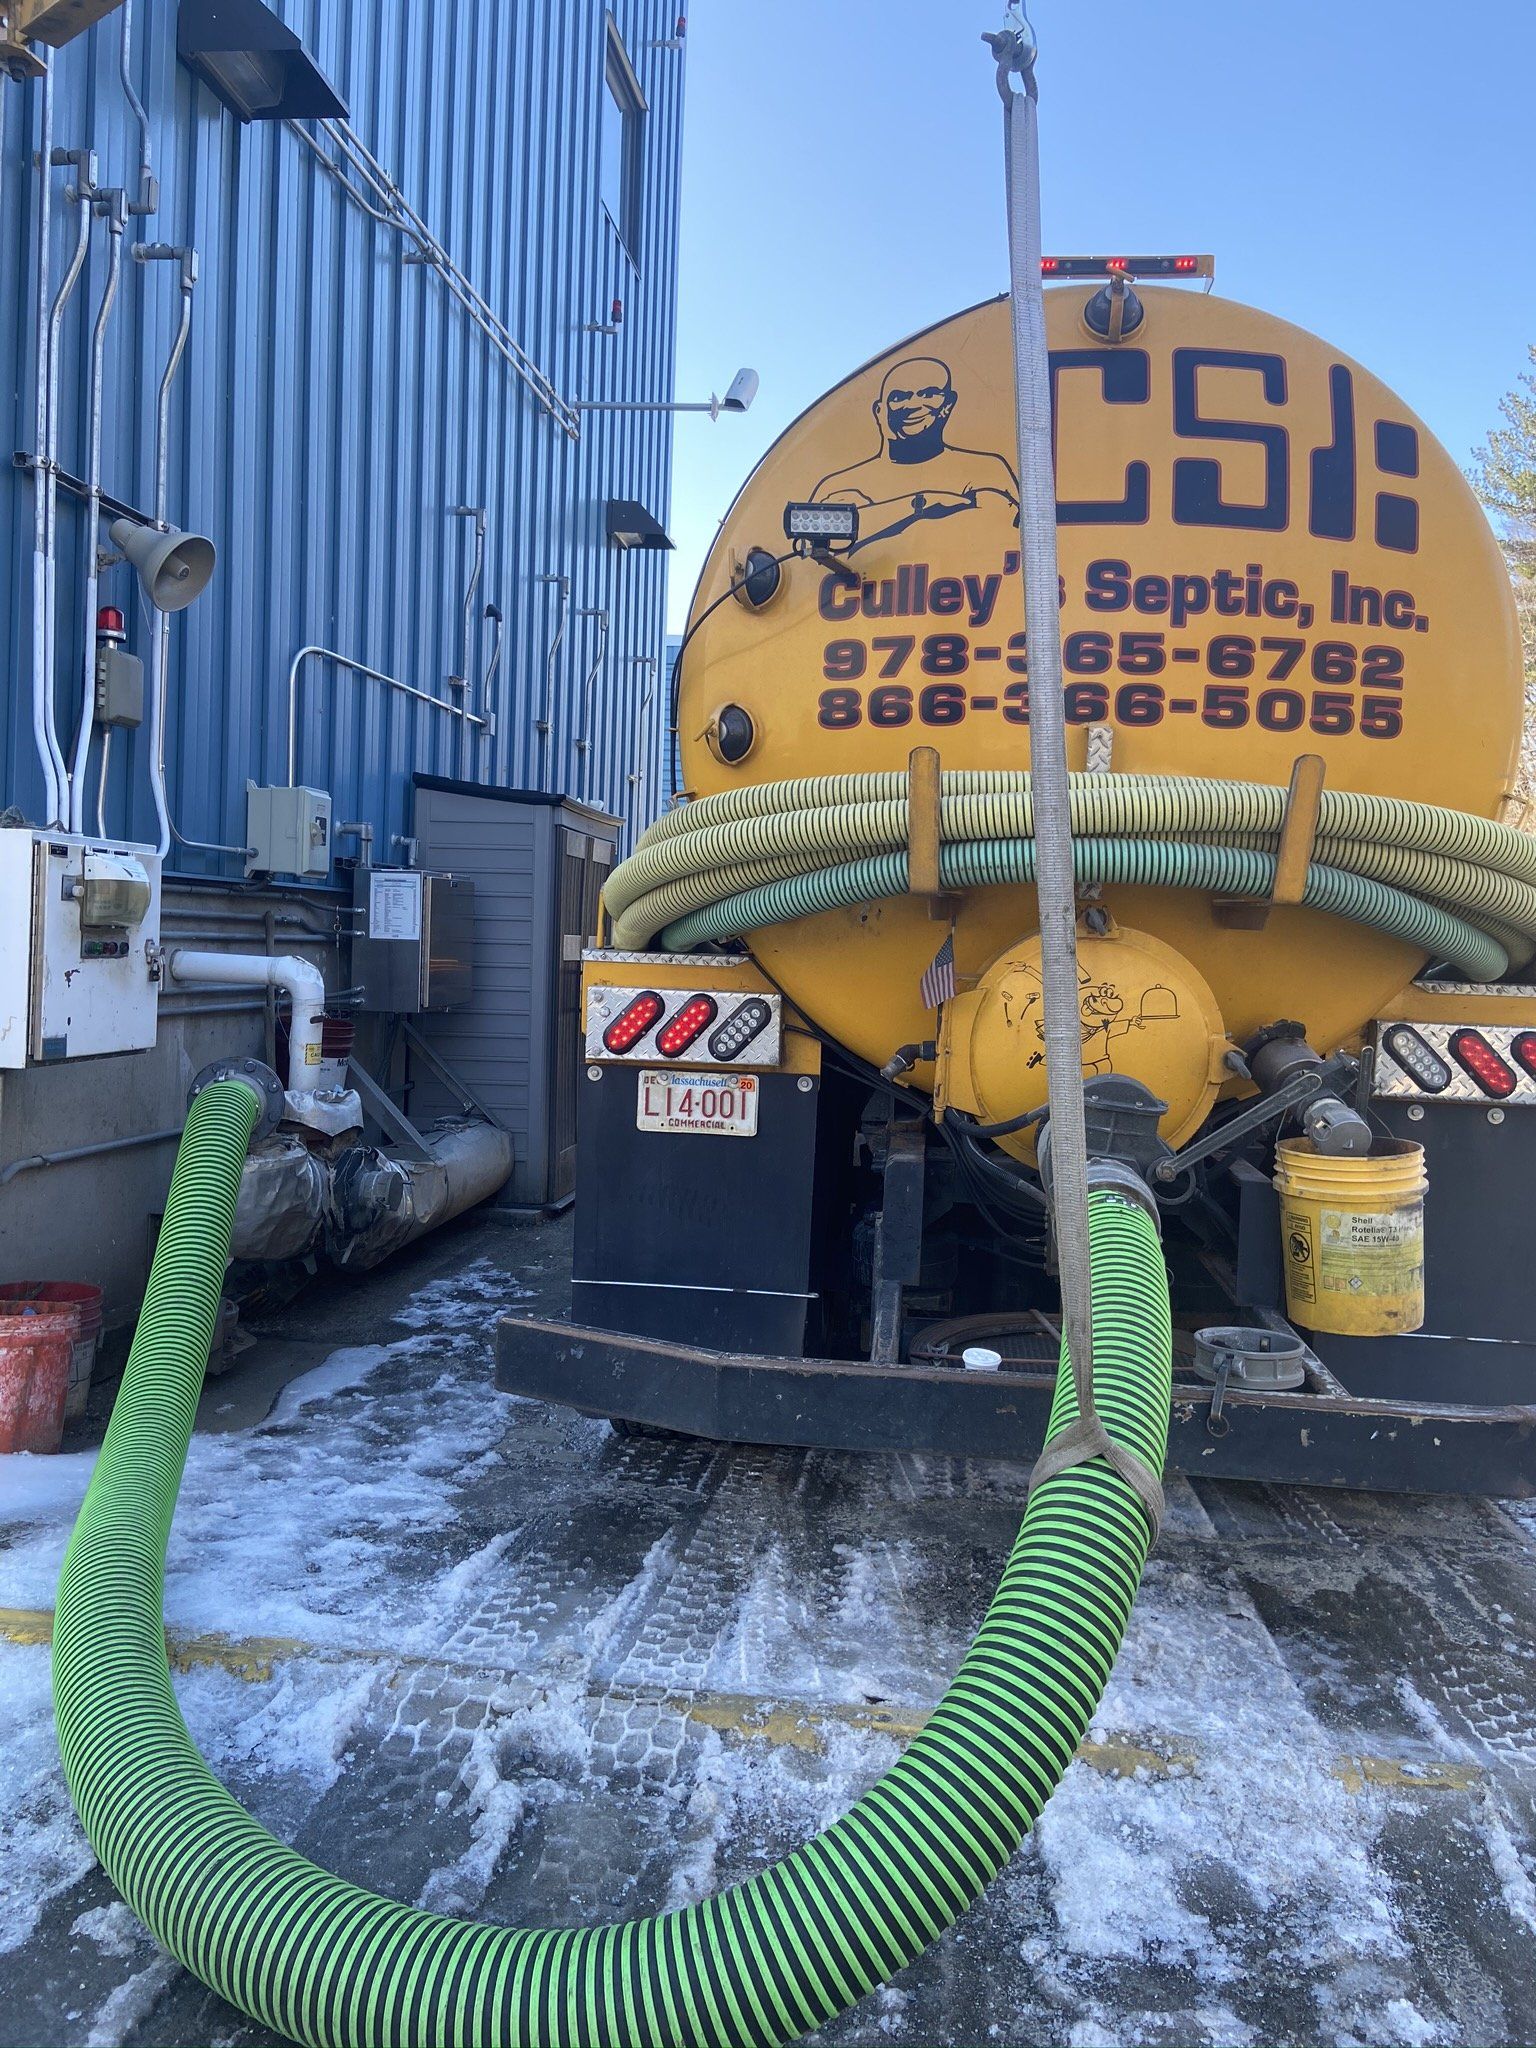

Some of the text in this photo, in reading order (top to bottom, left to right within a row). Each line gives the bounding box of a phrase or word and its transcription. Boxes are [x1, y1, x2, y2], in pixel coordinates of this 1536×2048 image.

[818, 550, 1429, 633] Culley' Septic, Inc.
[740, 1081, 752, 1090] 20
[668, 1117, 726, 1130] COMMERCIAL
[1351, 1216, 1373, 1224] Shell
[1351, 1235, 1370, 1243] SAE
